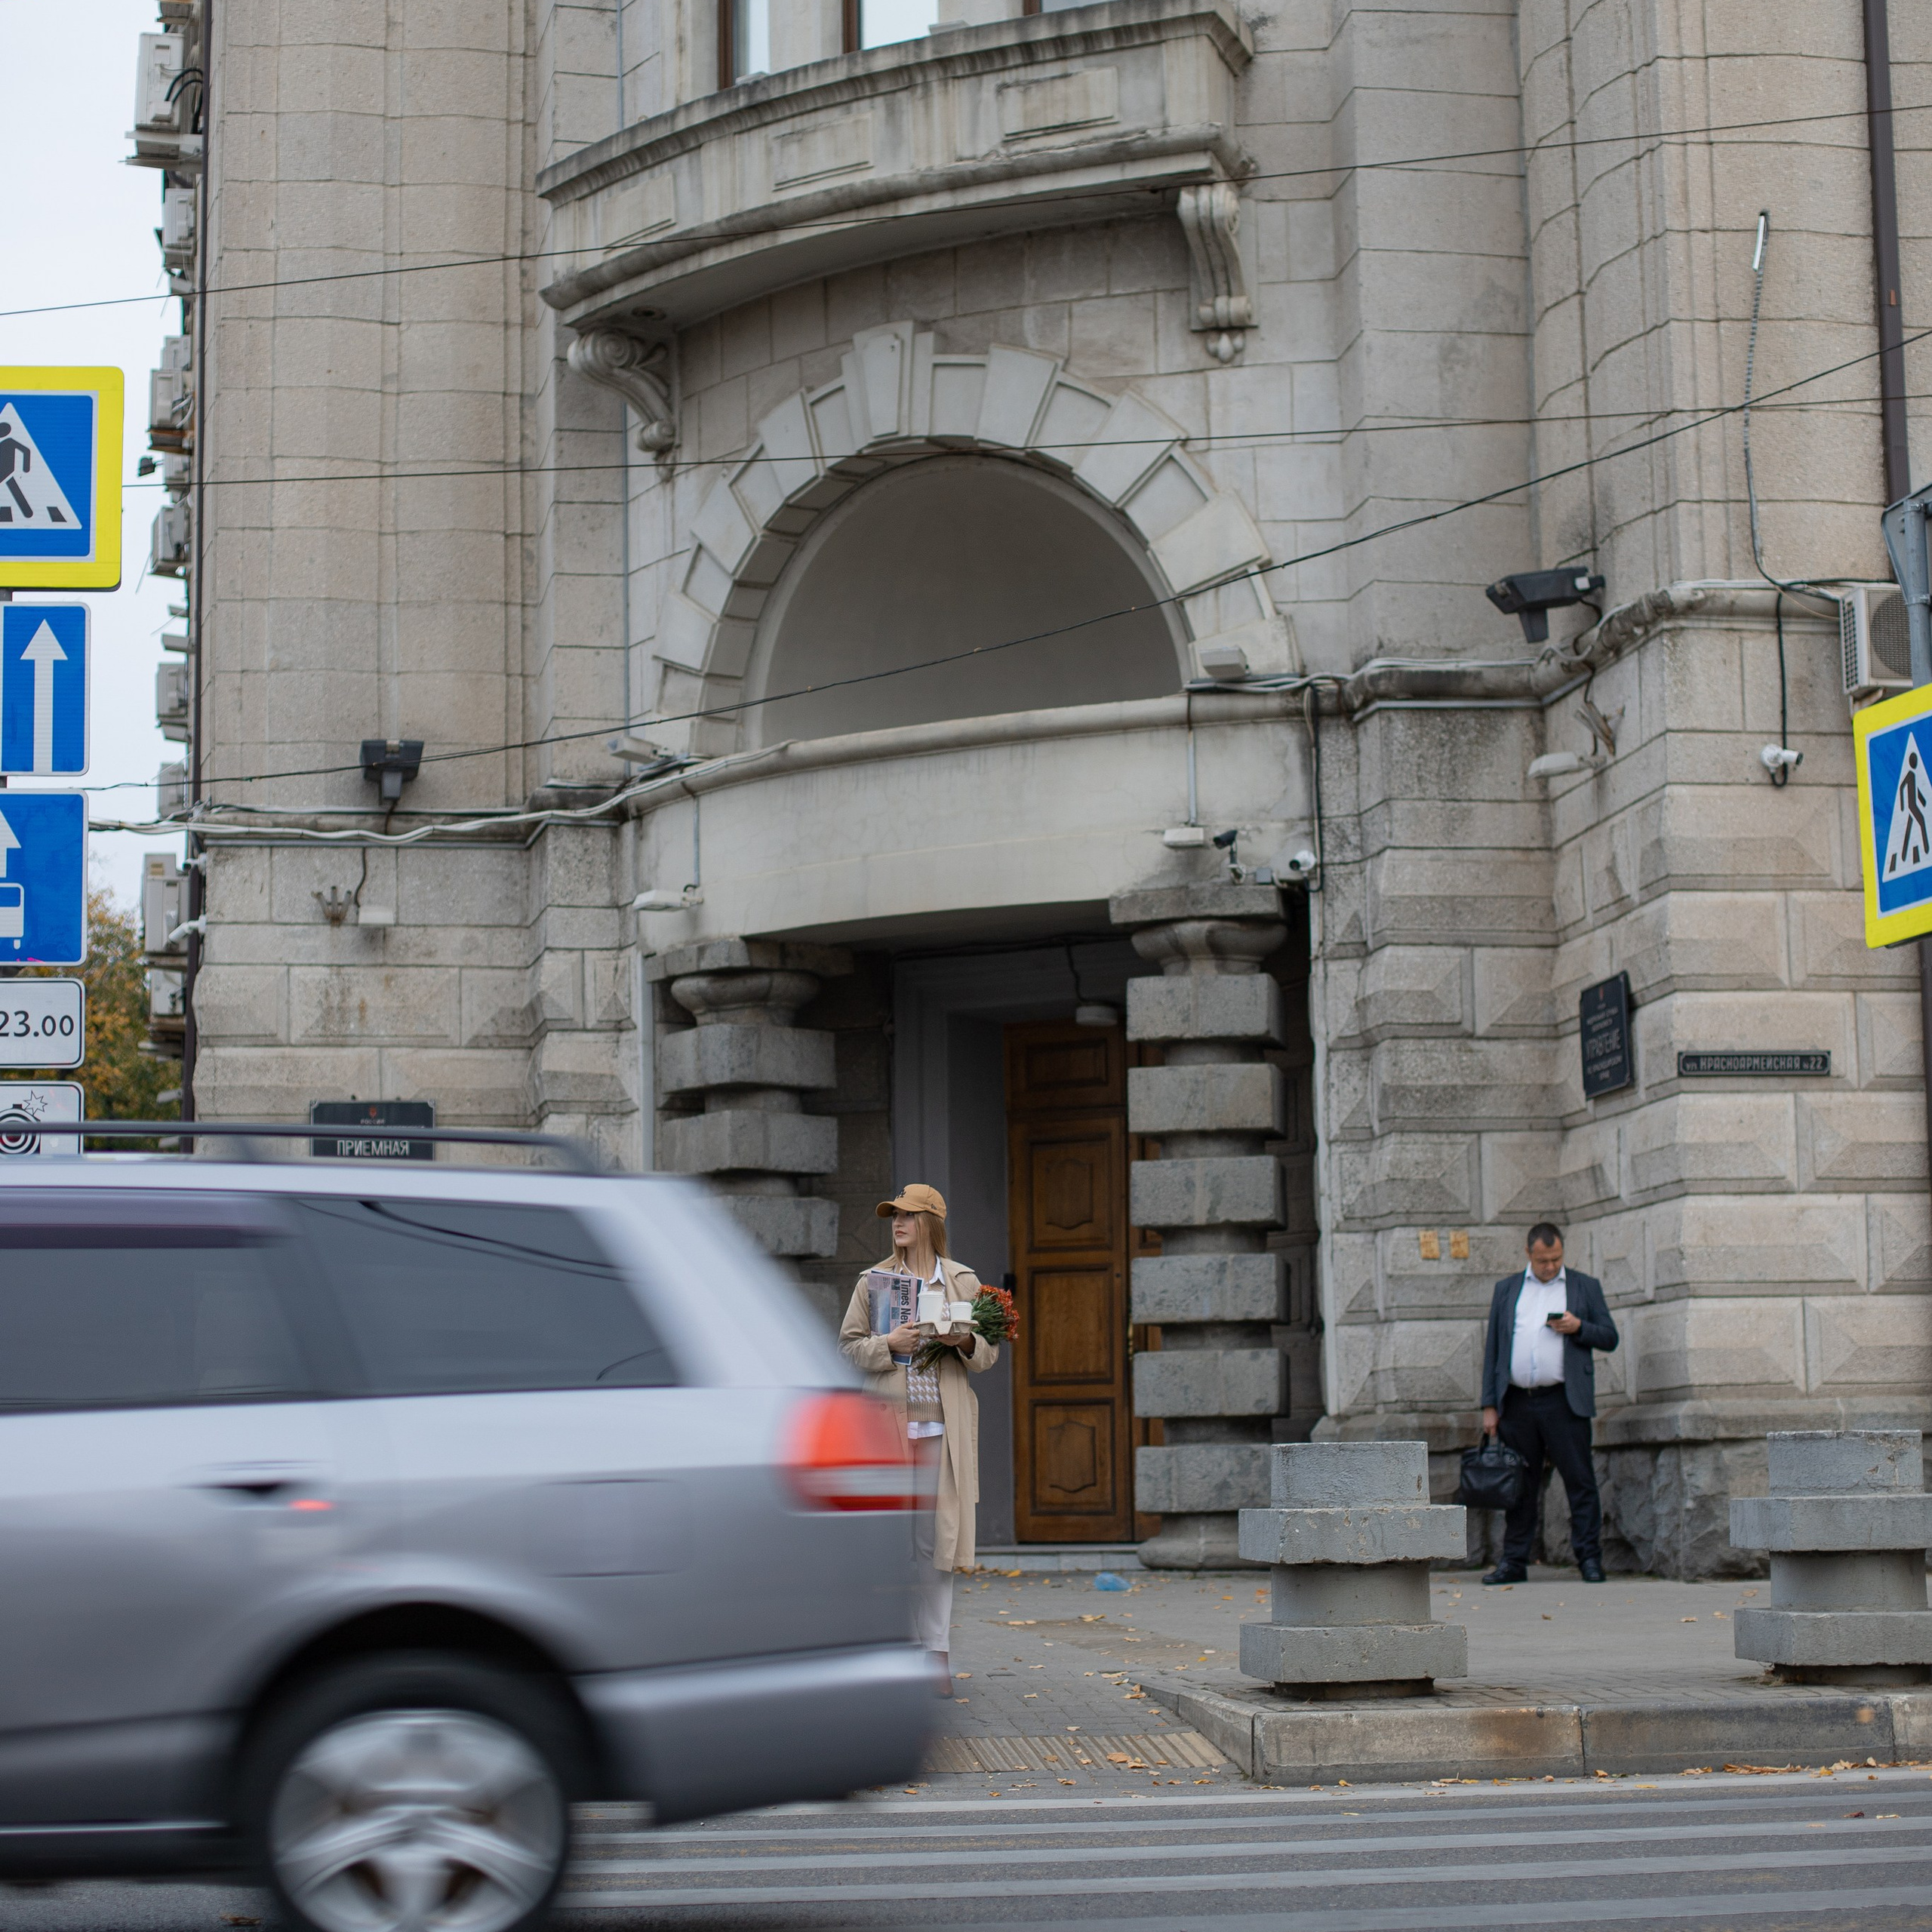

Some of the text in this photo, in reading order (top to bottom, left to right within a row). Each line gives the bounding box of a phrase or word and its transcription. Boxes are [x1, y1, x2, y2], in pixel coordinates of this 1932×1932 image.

[0, 1011, 74, 1037] 23.00
[337, 1140, 410, 1156] ПРИЕМНАЯ
[900, 1278, 911, 1306] Times
